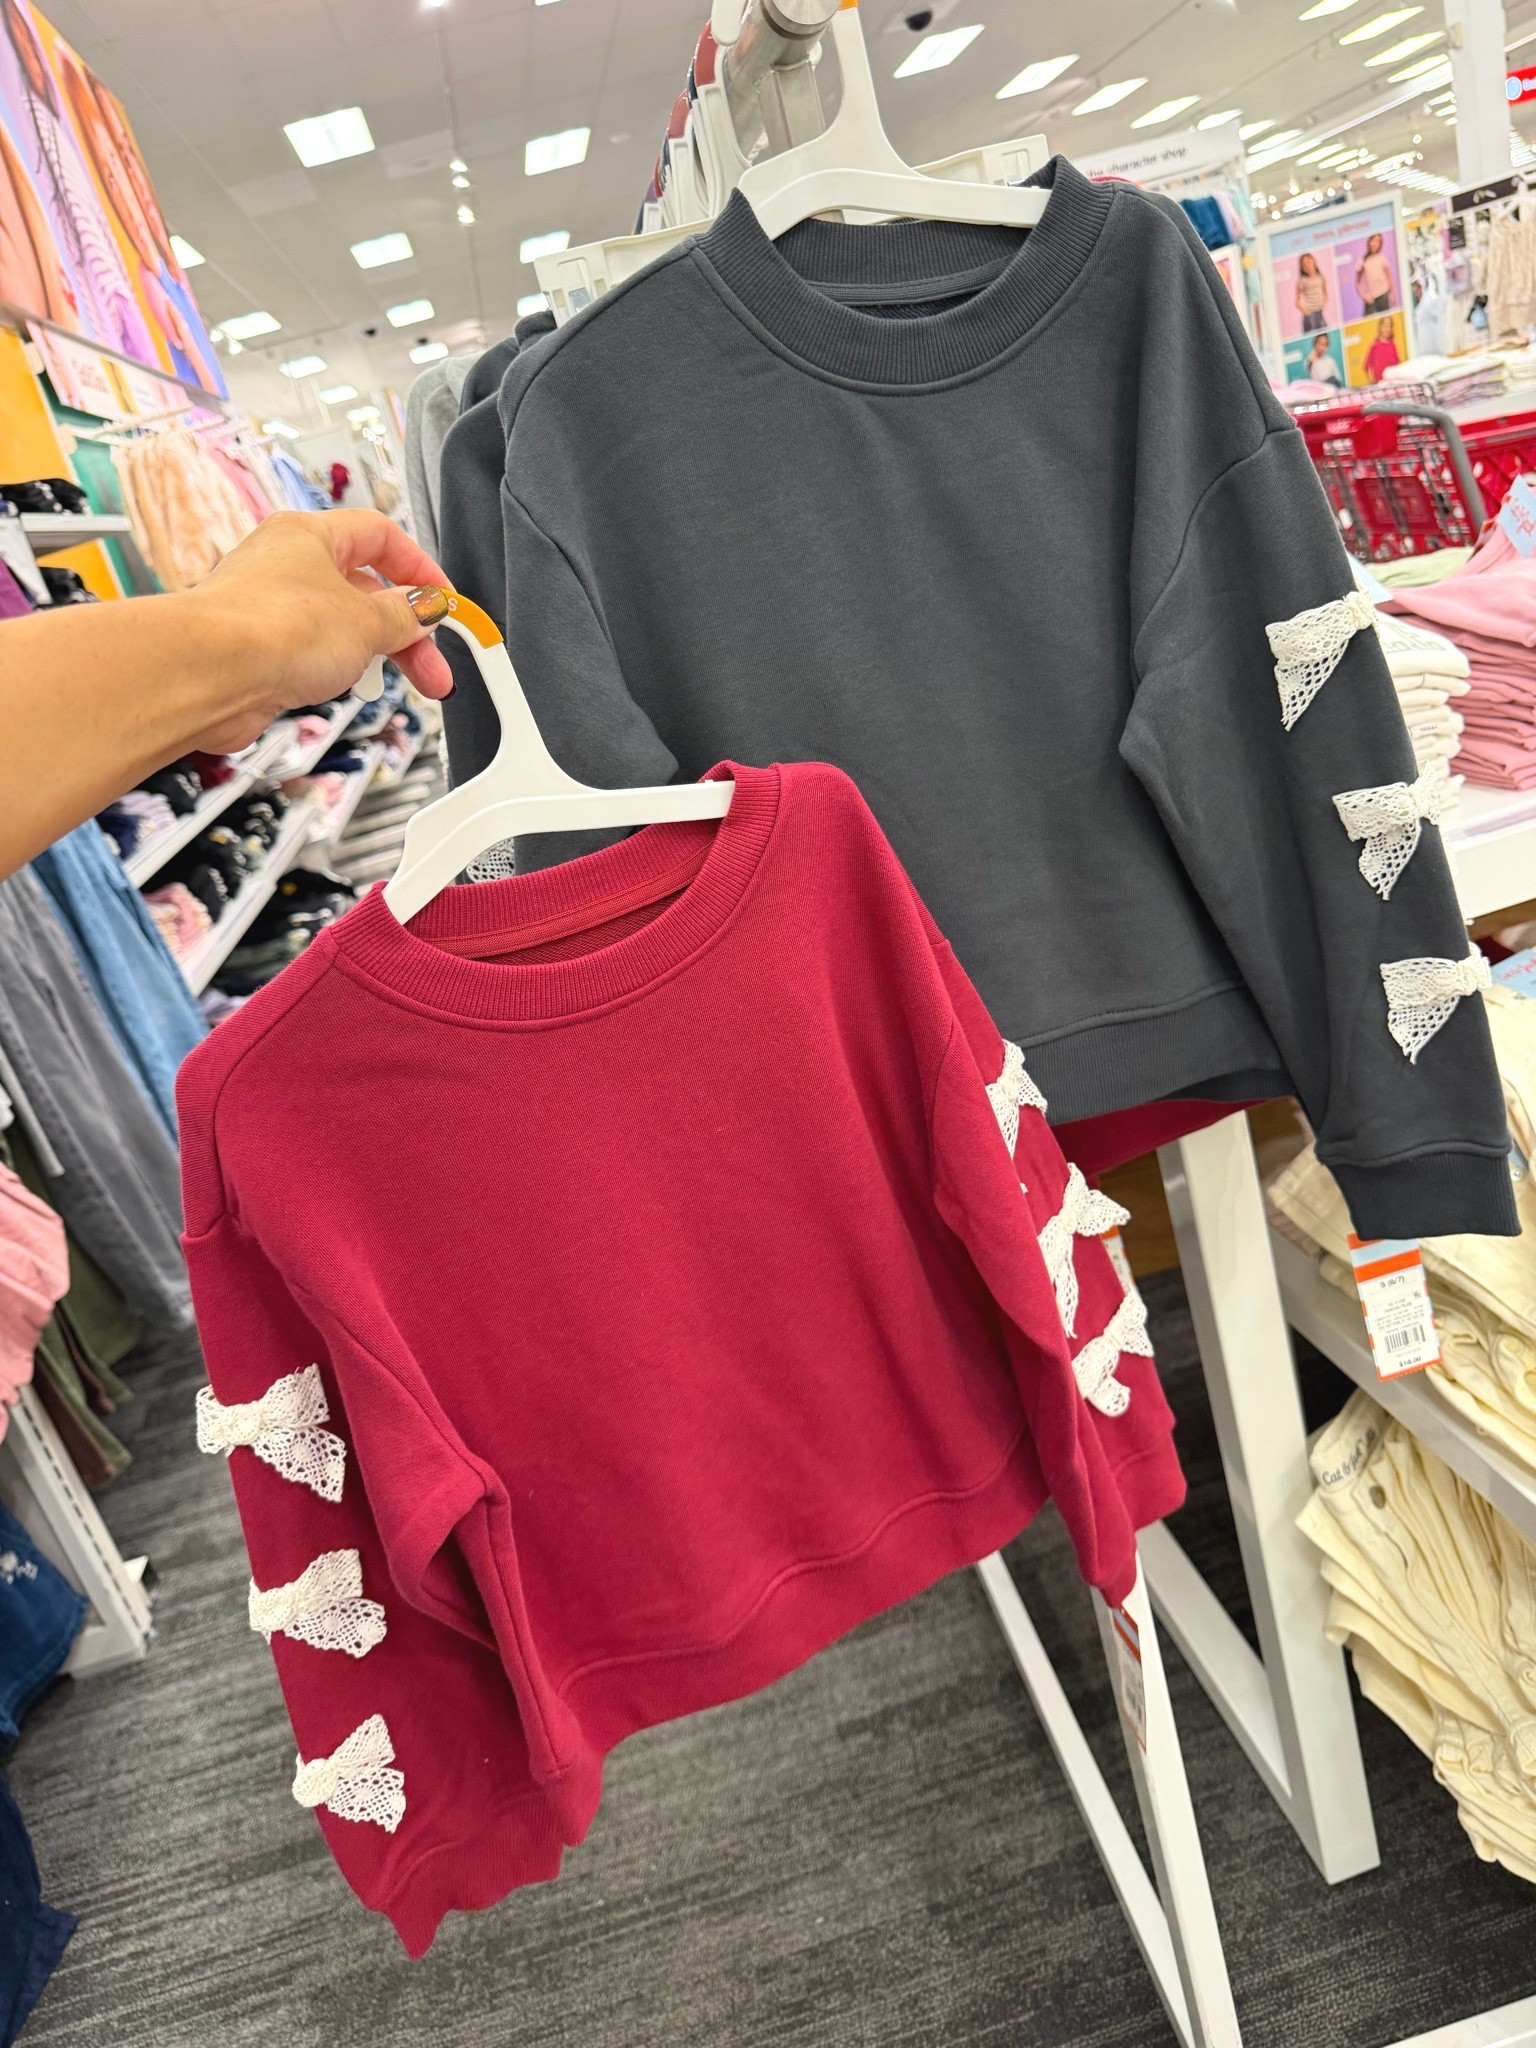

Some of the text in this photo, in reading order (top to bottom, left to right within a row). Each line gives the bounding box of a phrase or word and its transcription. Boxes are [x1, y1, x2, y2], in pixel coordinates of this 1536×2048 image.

[1108, 155, 1158, 171] character
[448, 597, 458, 611] S
[1322, 1465, 1343, 1484] Cat
